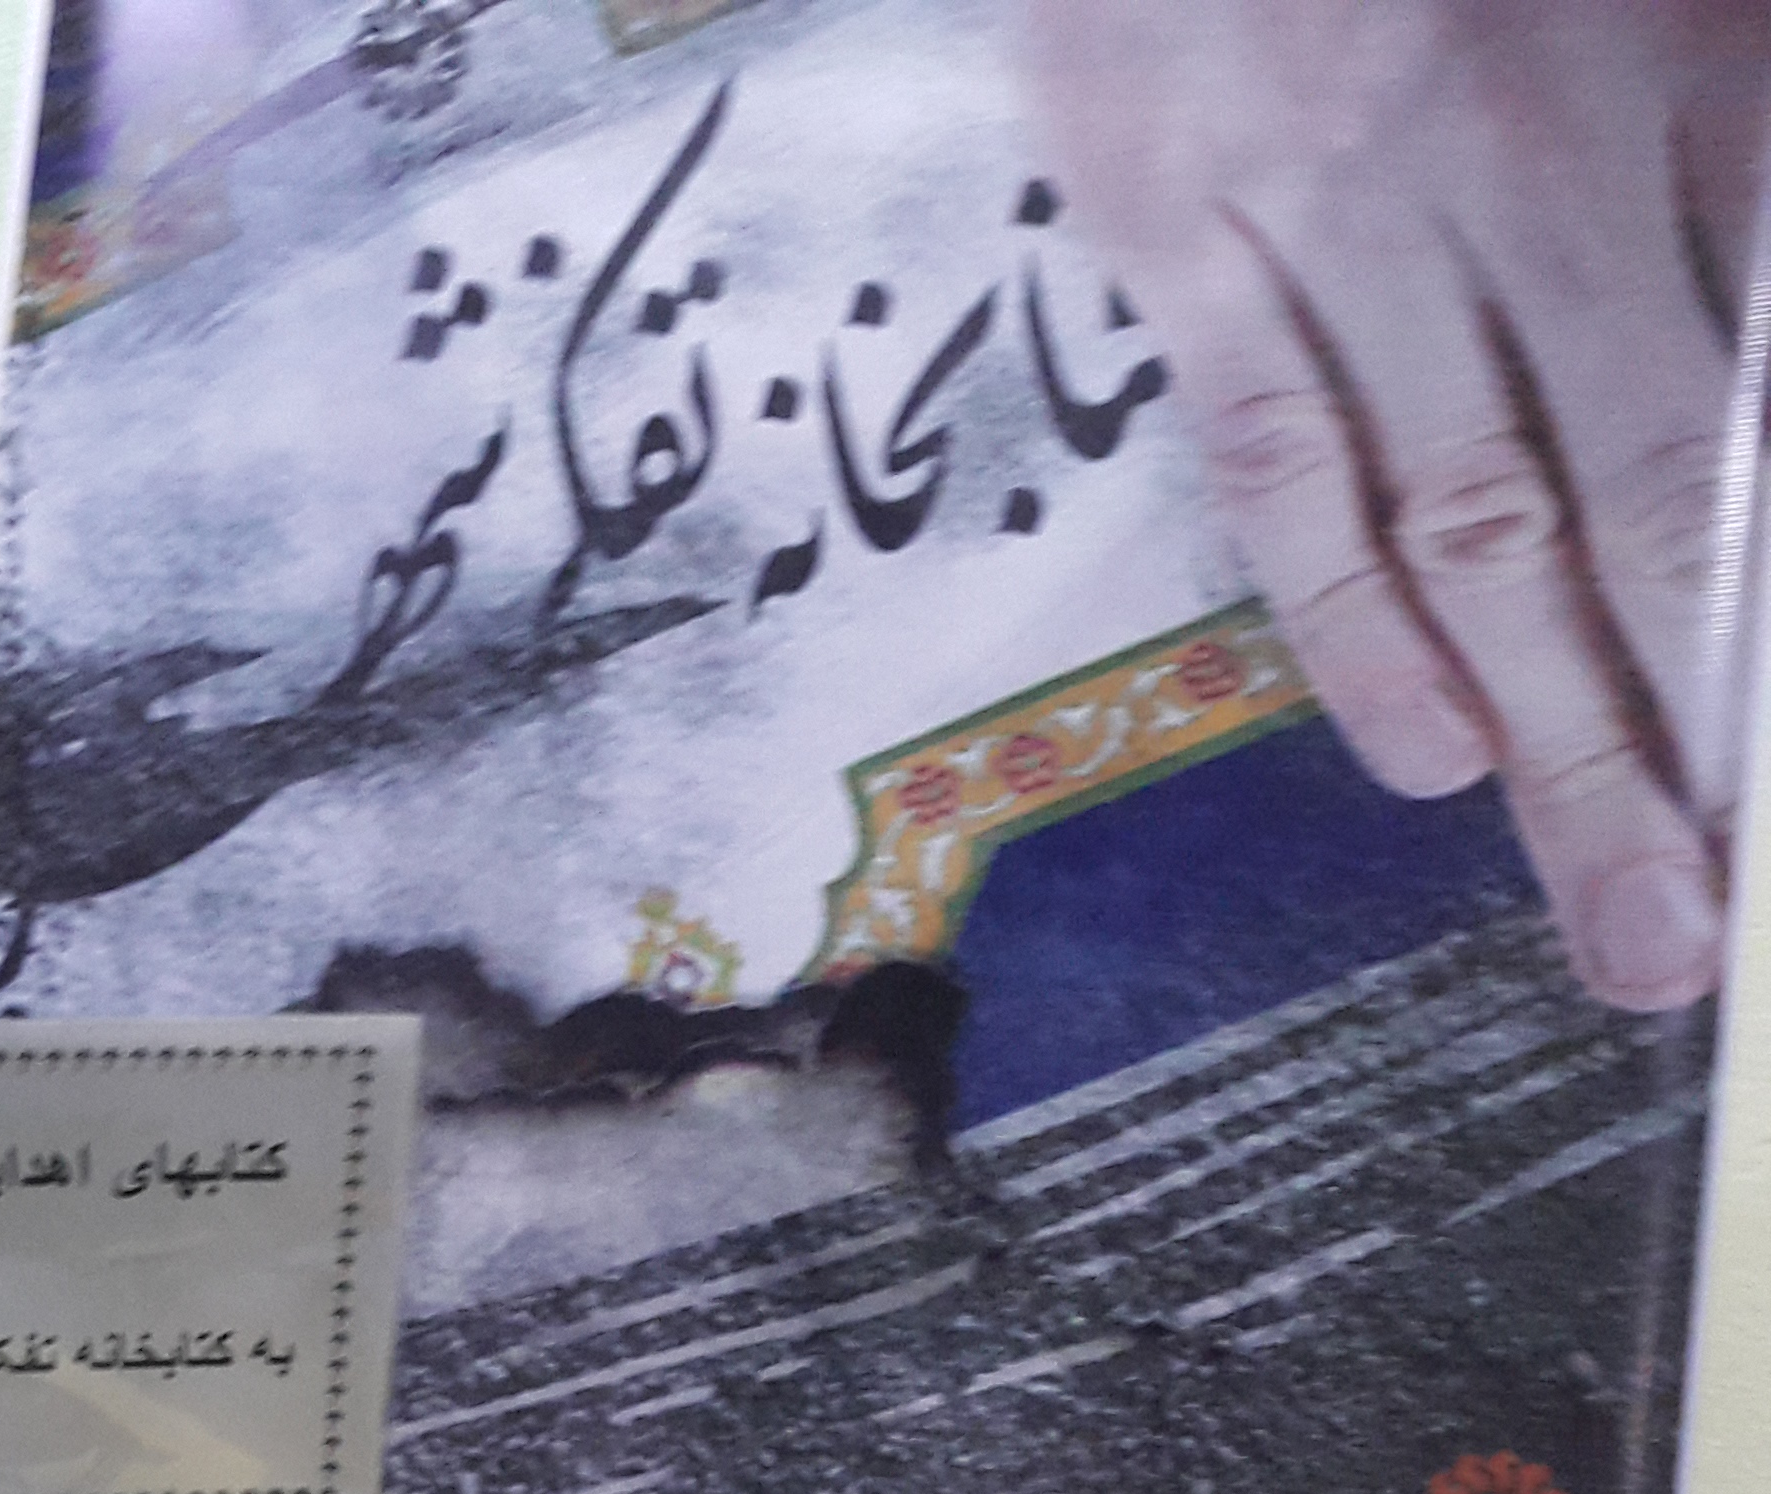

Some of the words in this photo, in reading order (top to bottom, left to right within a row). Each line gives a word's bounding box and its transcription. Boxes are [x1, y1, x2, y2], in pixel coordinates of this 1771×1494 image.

[112, 1138, 291, 1199] کتابهای
[74, 1328, 237, 1381] کتابخانه
[250, 1336, 297, 1379] به
